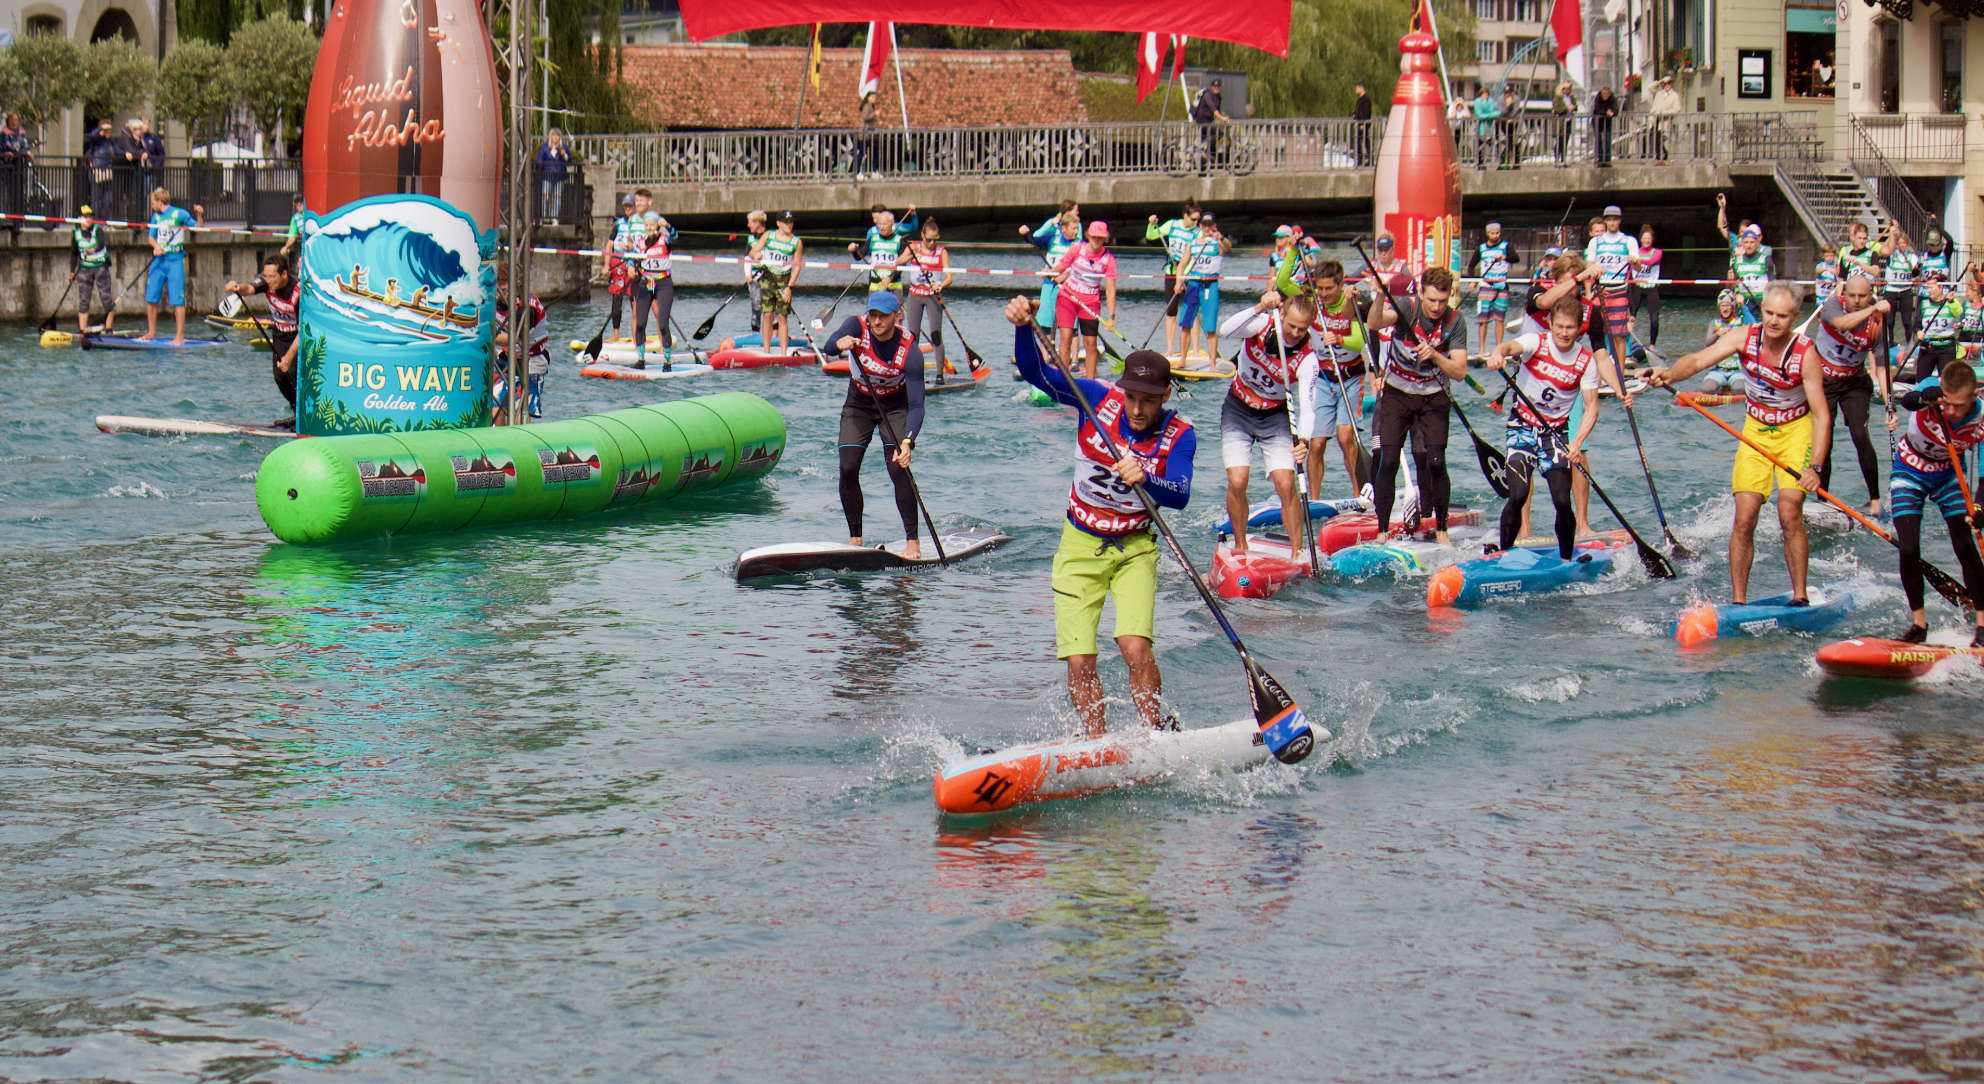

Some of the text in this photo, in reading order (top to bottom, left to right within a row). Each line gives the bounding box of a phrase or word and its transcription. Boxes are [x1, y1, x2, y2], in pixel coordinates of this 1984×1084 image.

[331, 65, 413, 119] Liquid
[347, 108, 446, 152] Aloha
[1600, 255, 1622, 264] 223
[1835, 344, 1859, 358] 17
[338, 362, 473, 391] BIG WAVE
[1249, 366, 1275, 388] 19
[363, 392, 449, 411] Golden Ale
[1541, 386, 1557, 401] 6
[1890, 651, 1935, 663] NAISH
